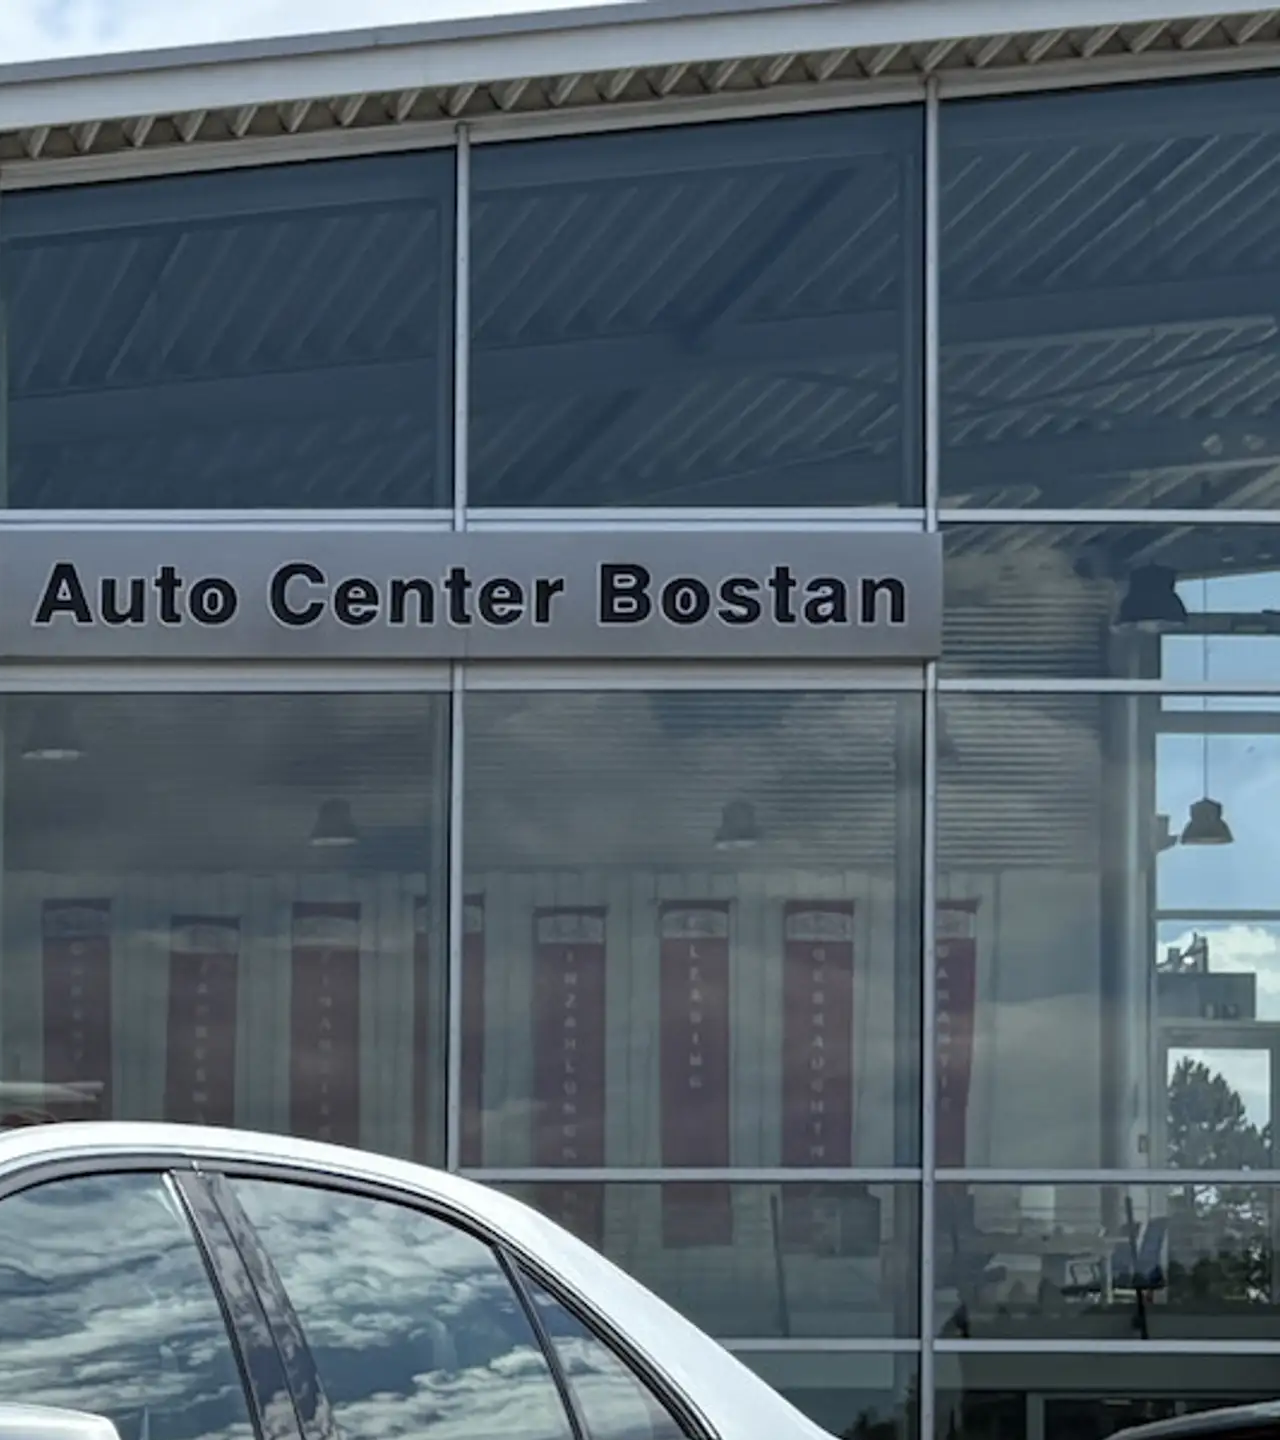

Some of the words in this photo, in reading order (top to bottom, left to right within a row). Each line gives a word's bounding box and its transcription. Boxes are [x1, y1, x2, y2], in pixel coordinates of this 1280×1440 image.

[34, 560, 237, 627] Auto
[268, 560, 564, 627] Center
[597, 560, 907, 627] Bostan
